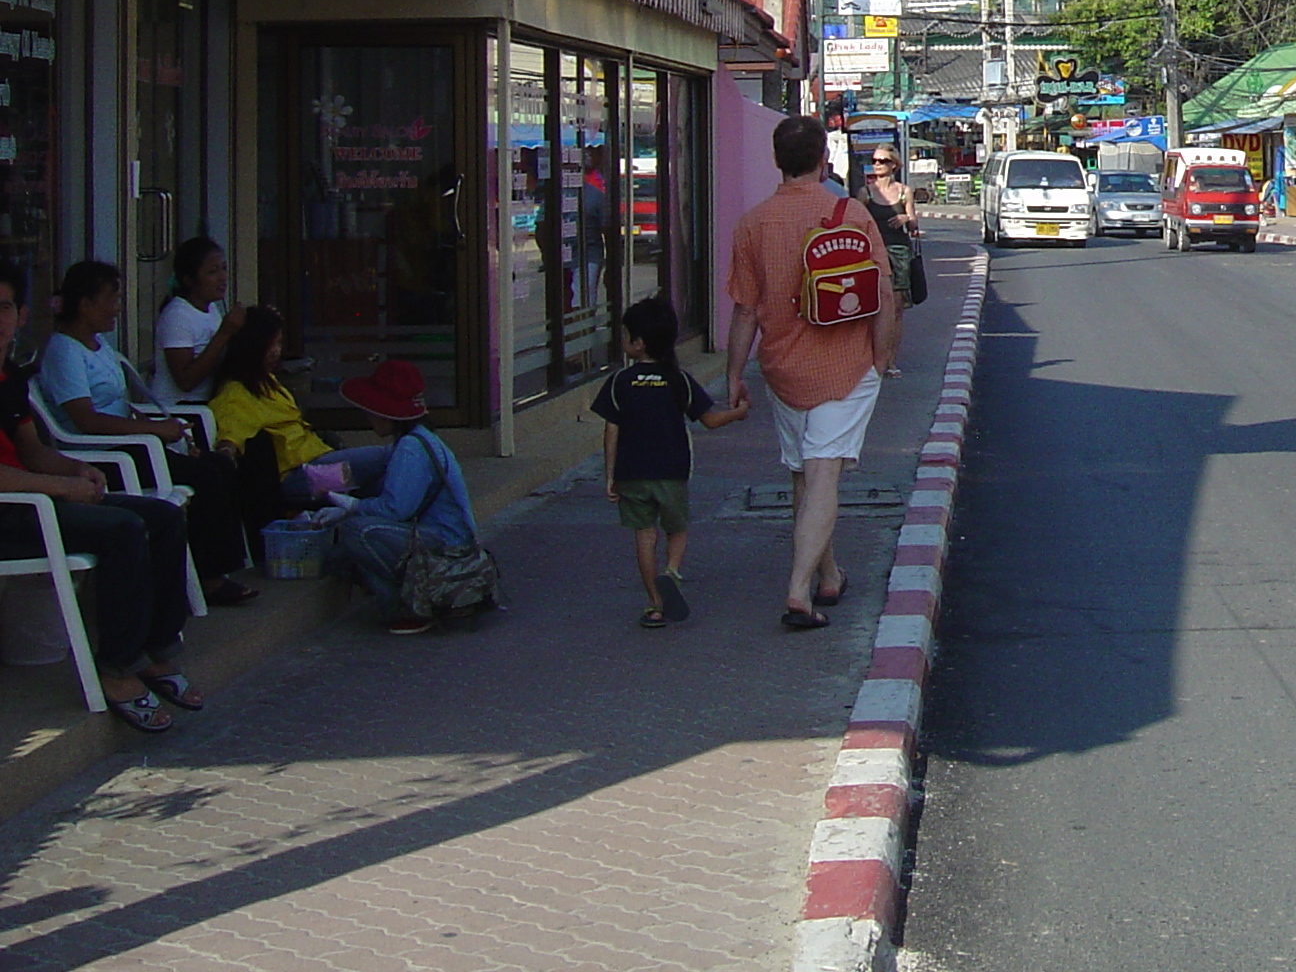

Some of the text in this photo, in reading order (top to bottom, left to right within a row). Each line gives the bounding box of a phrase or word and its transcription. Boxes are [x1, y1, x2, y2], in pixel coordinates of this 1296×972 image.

[859, 41, 884, 52] Lady
[1222, 133, 1261, 152] DVD
[332, 146, 424, 161] WELCOME
